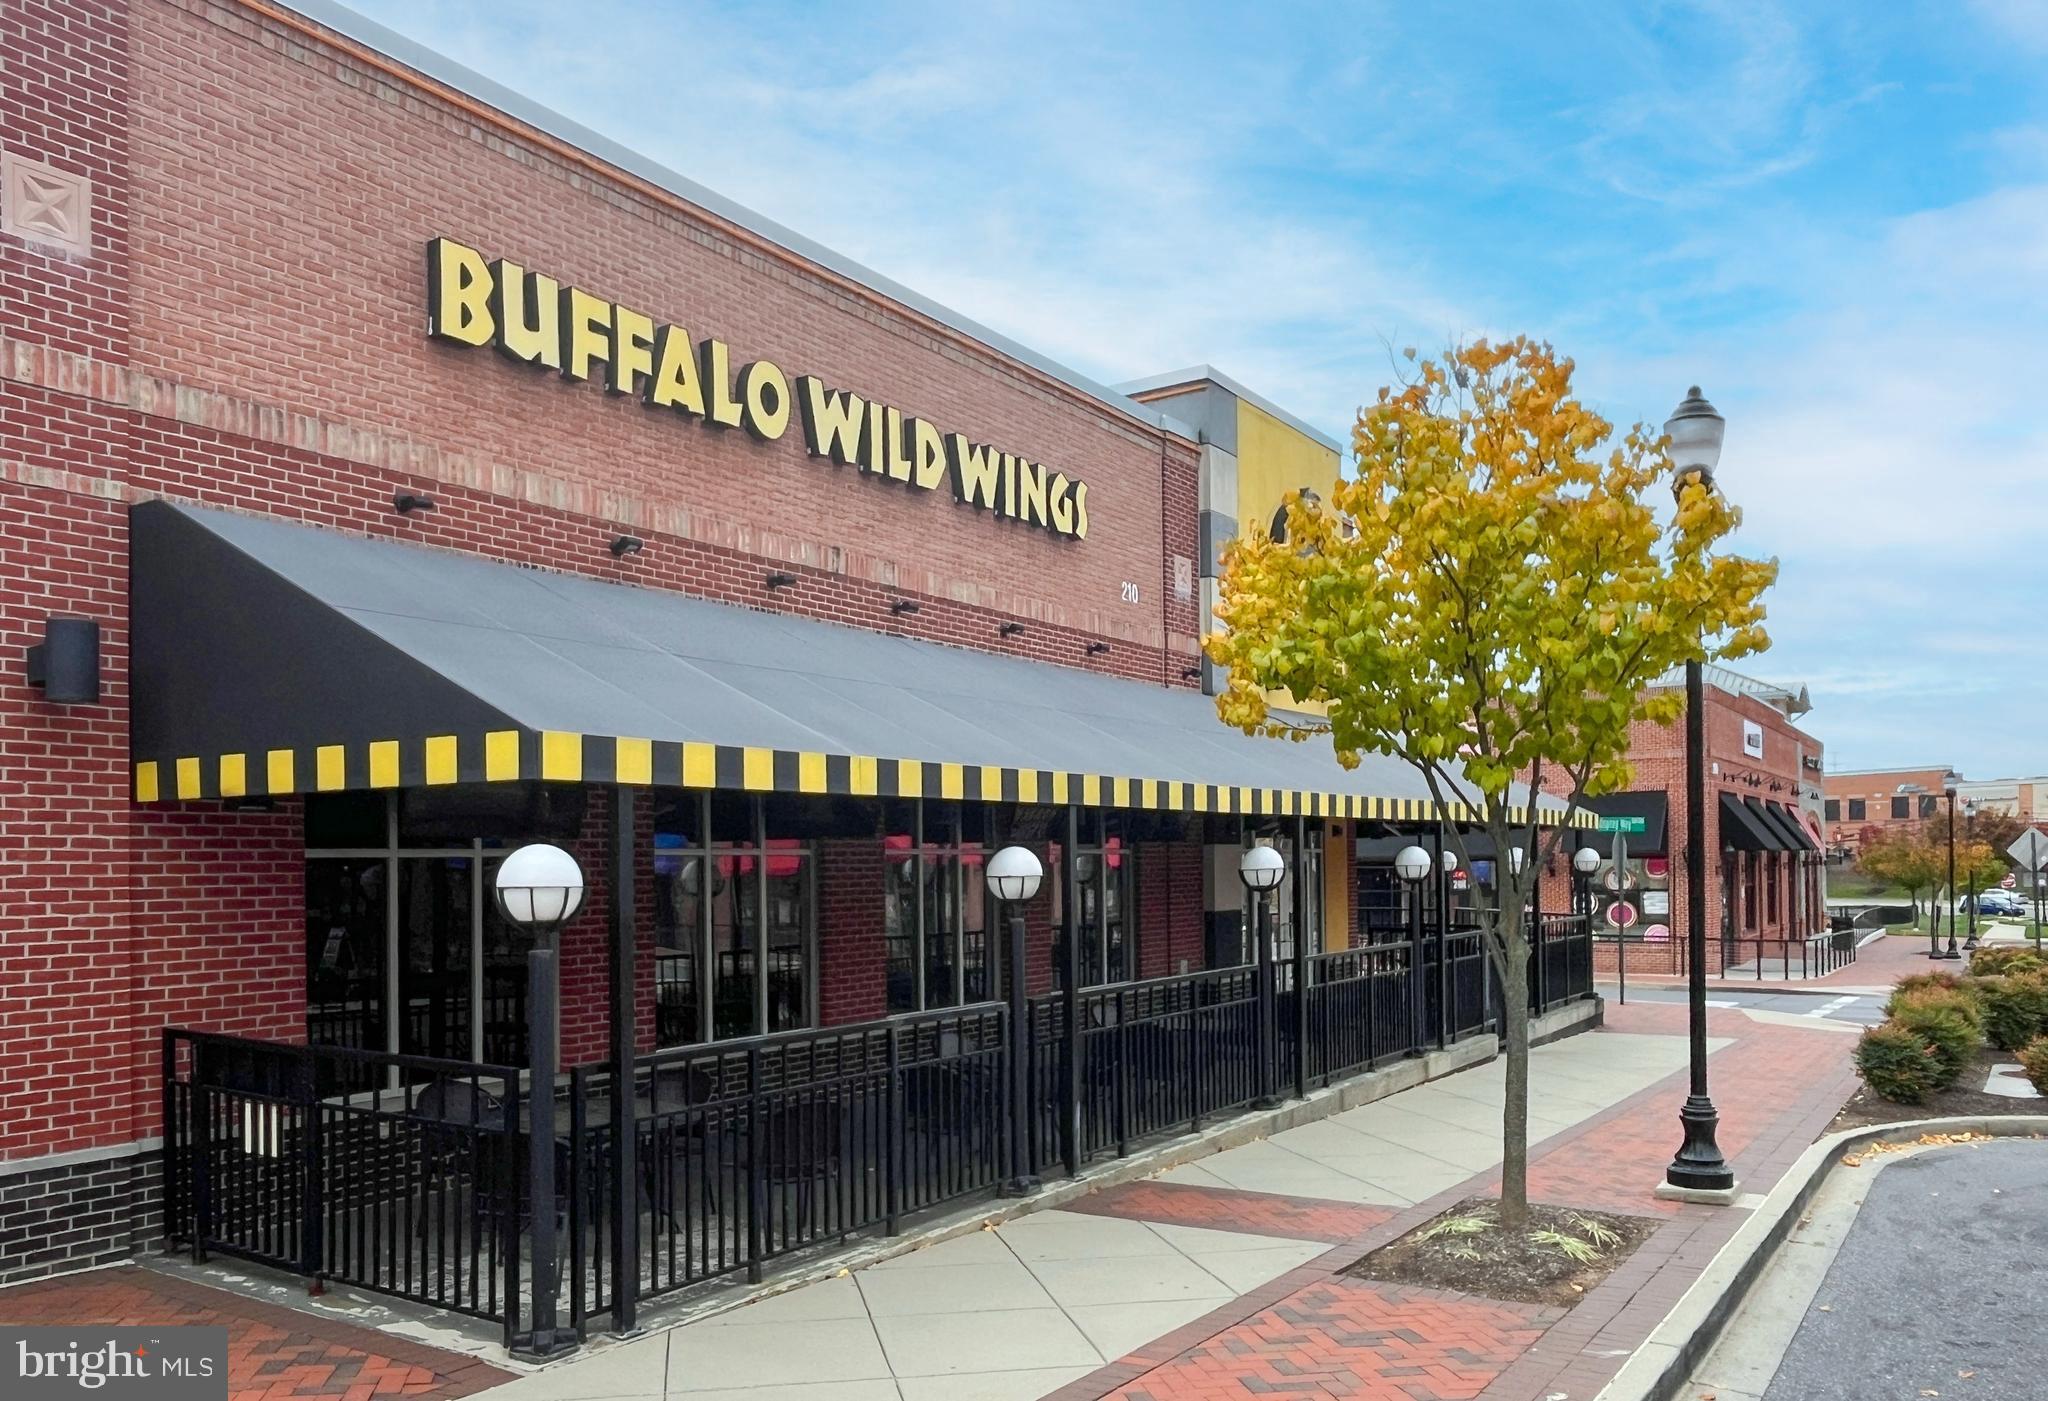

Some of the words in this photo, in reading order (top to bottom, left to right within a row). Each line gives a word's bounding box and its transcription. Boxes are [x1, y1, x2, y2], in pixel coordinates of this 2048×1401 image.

[428, 237, 791, 441] BUFFALO
[797, 375, 947, 490] WILD
[946, 432, 1089, 540] WINGS
[1121, 581, 1139, 603] 210
